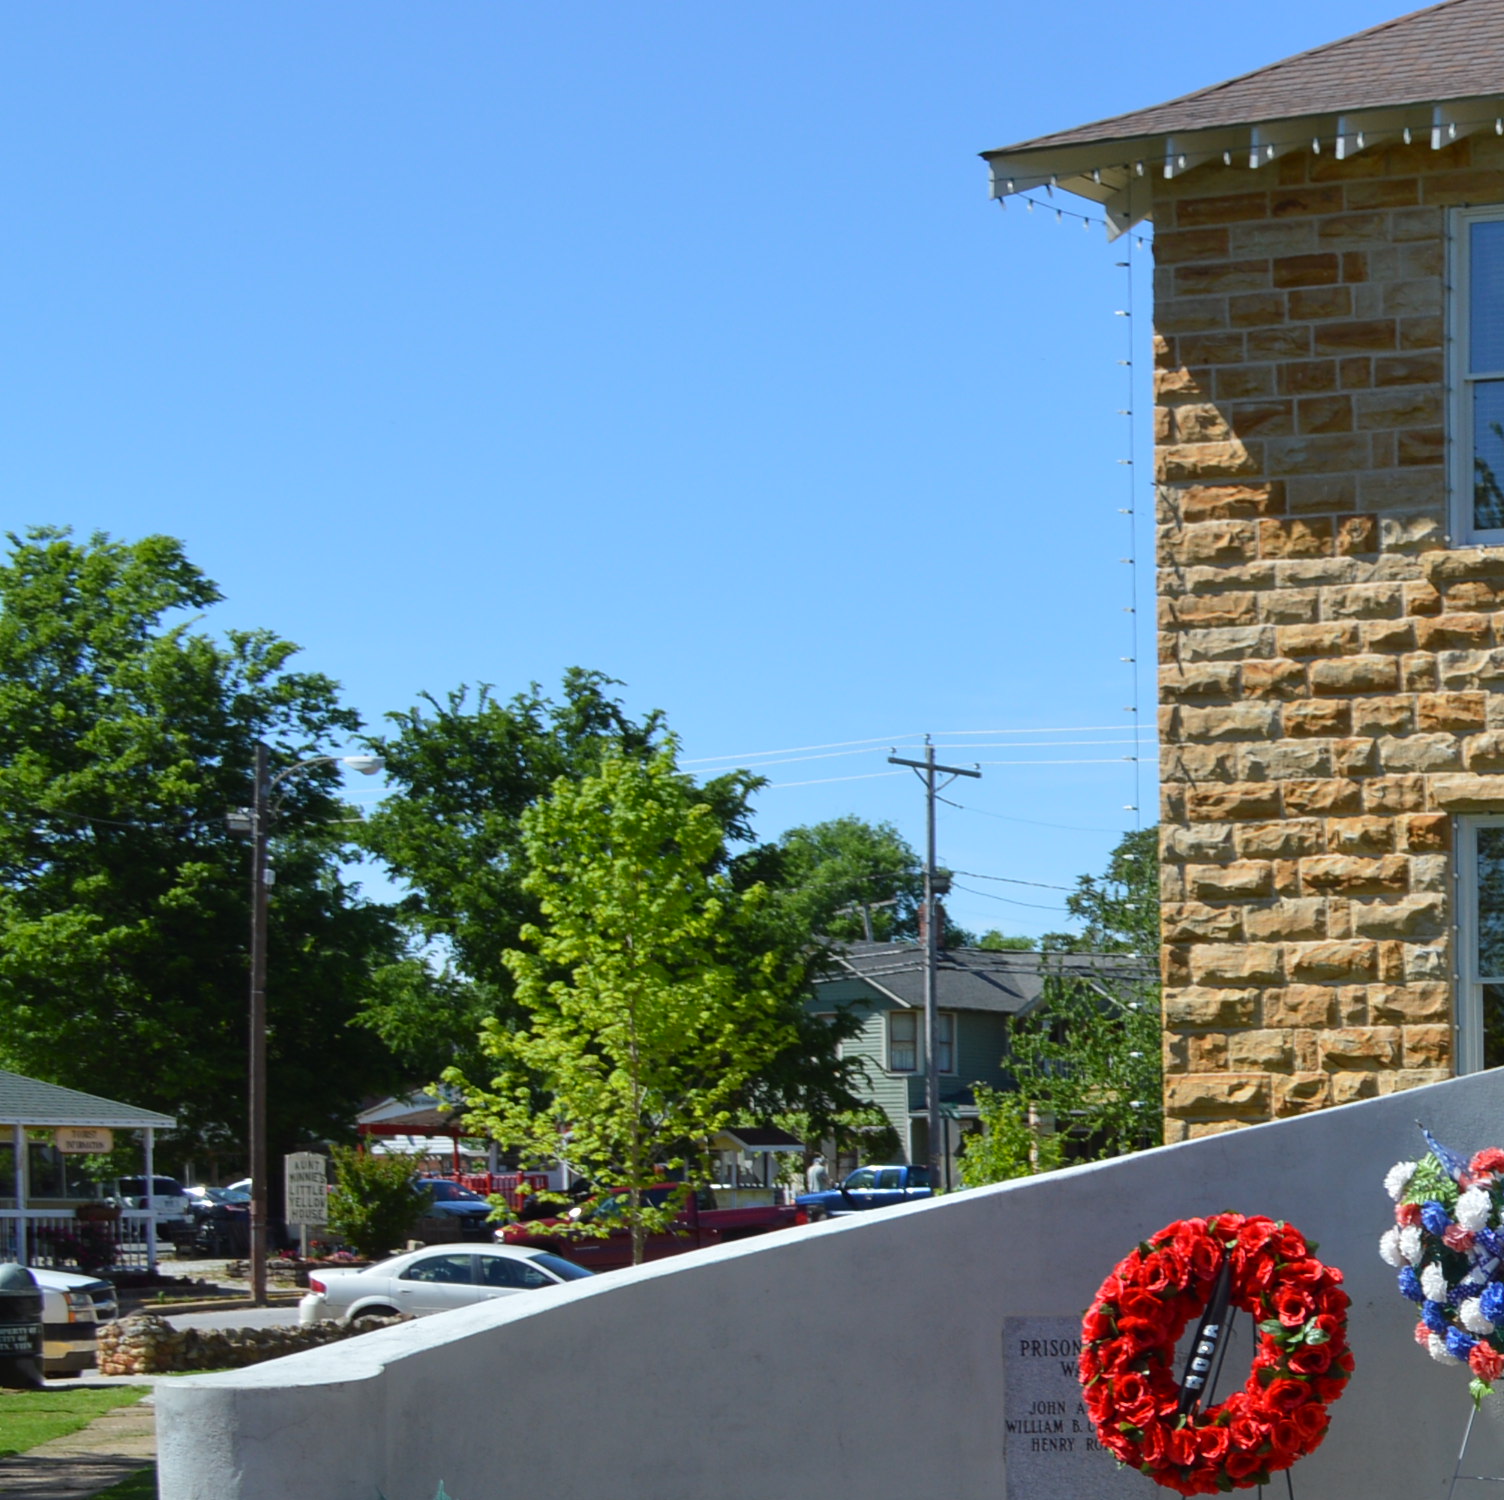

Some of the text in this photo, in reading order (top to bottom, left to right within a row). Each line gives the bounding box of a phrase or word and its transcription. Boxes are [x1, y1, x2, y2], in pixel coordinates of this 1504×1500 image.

[295, 1161, 320, 1170] AUNT
[288, 1184, 325, 1196] LITTLE
[292, 1209, 325, 1220] HOUSE
[1020, 1340, 1081, 1357] PRISON
[1029, 1401, 1066, 1416] JOHN
[1006, 1420, 1064, 1435] WILLIAM
[1073, 1421, 1083, 1434] B.
[1031, 1437, 1075, 1452] HENRY
